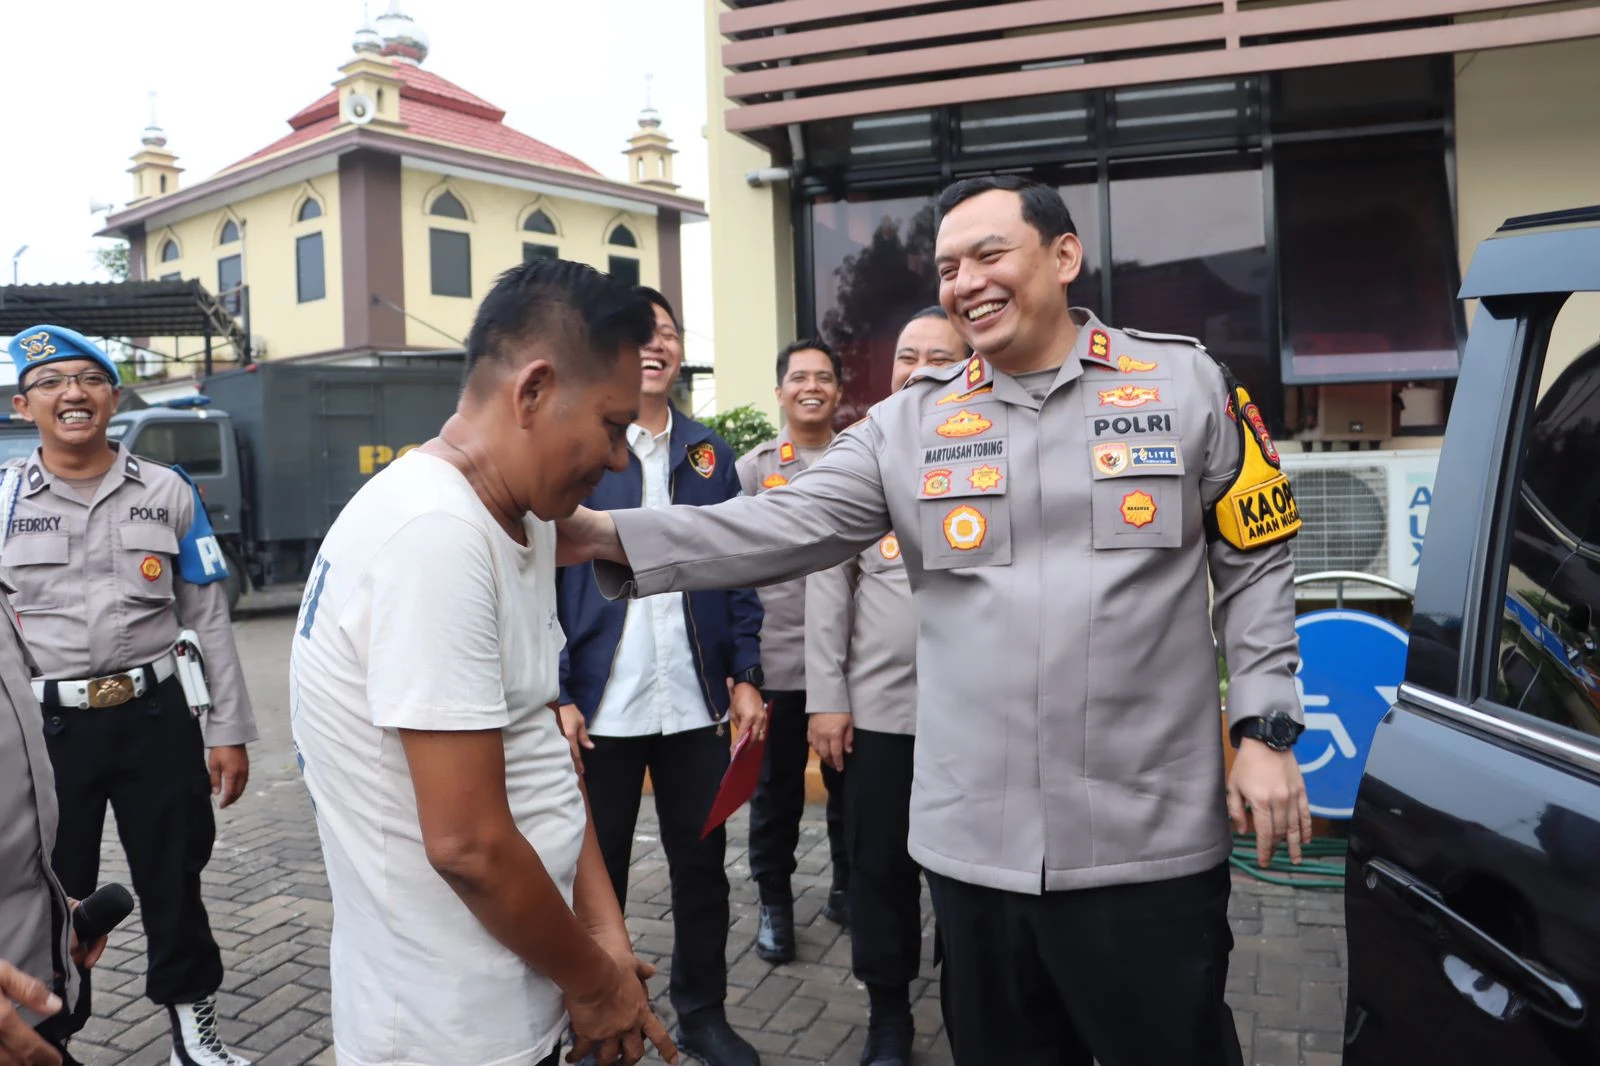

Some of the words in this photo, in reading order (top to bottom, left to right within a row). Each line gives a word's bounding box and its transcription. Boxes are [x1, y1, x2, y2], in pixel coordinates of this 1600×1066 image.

[1094, 414, 1171, 436] POLRI
[358, 443, 422, 475] P
[924, 444, 972, 464] MARTUASAH
[973, 440, 1003, 457] TOBING
[11, 516, 62, 534] FEDRIXY
[130, 506, 169, 524] POLRI
[1249, 518, 1280, 540] AMAN
